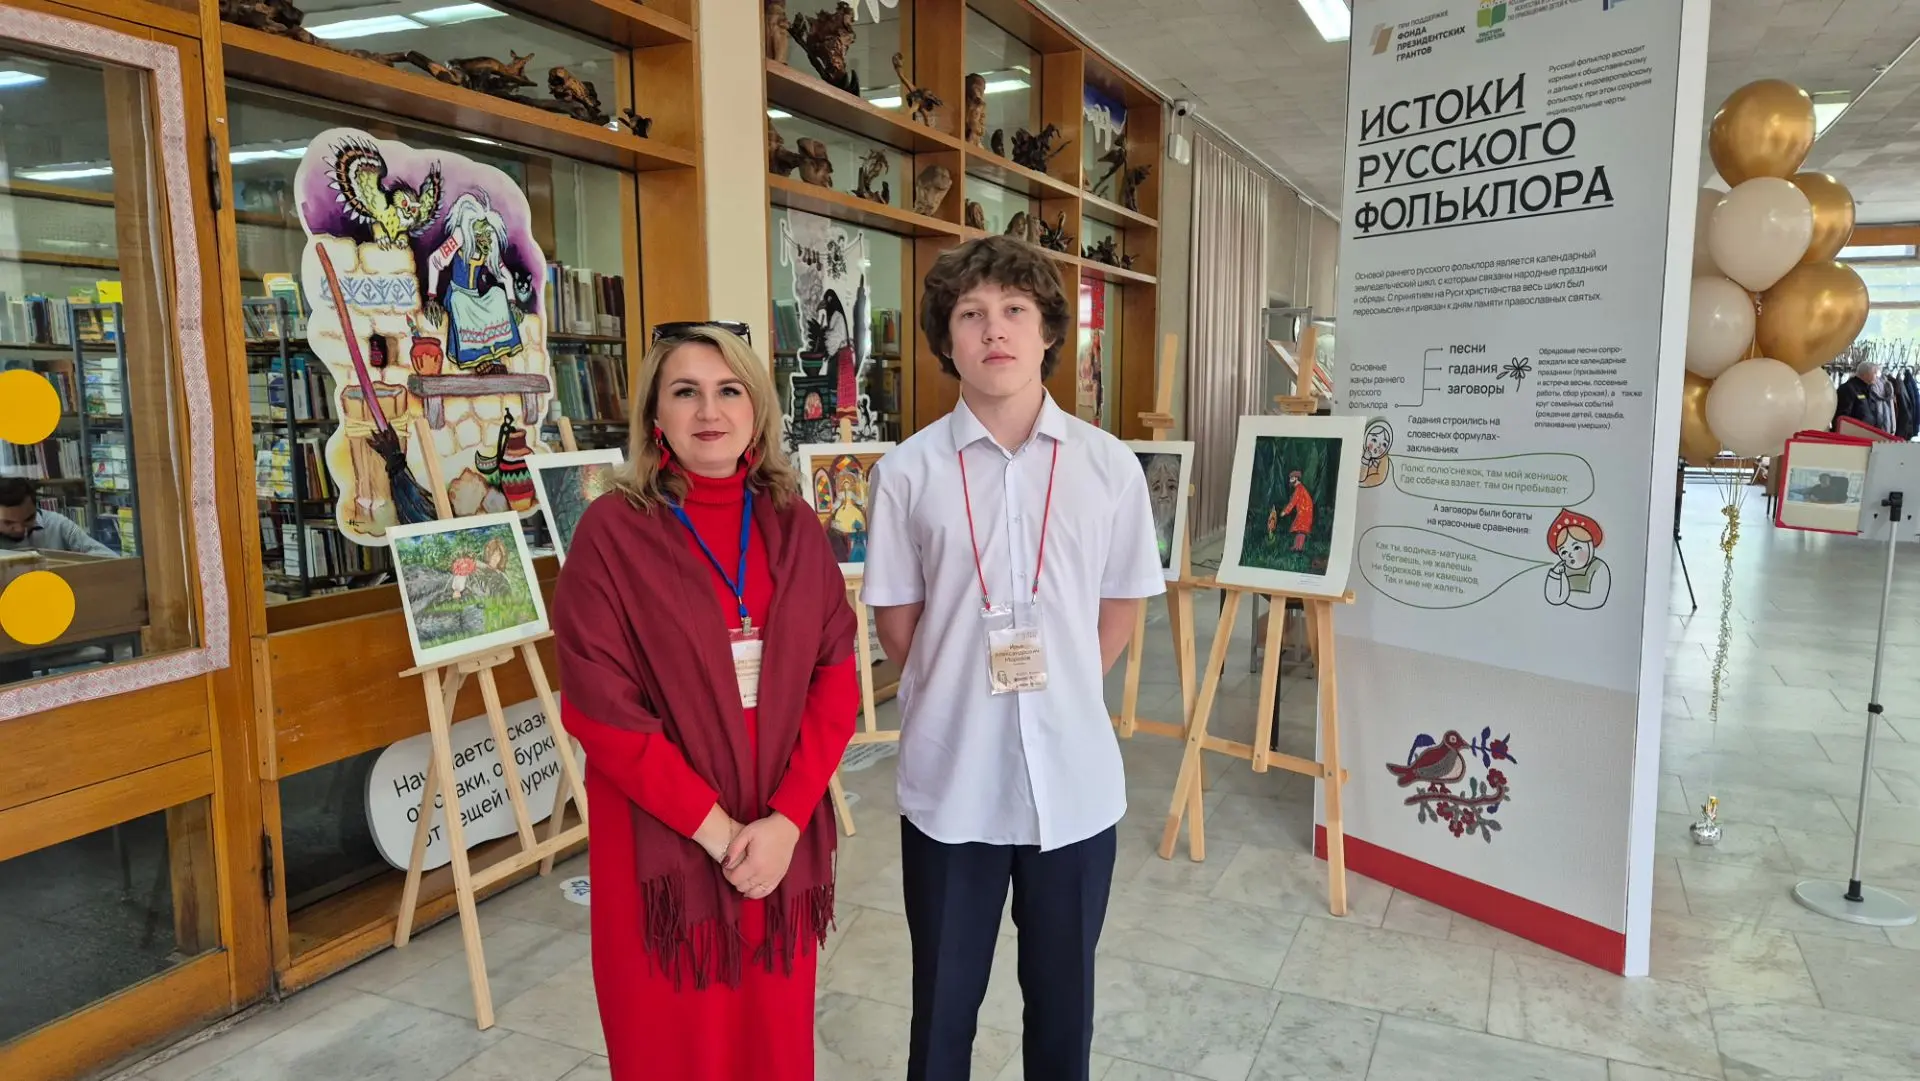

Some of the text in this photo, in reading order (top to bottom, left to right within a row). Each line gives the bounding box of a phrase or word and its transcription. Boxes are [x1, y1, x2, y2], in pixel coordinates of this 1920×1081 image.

[1397, 26, 1465, 51] ПРЕЗИДЕНТСКИХ
[1398, 26, 1426, 40] ФОНДА
[1396, 46, 1432, 62] ГРАНТОВ
[1549, 45, 1645, 72] Русский фольклор восходит
[1582, 56, 1647, 76] общеславянскому
[1553, 83, 1578, 94] дальше
[1584, 67, 1653, 87] индоевропейскому
[1585, 90, 1599, 99] при
[1599, 86, 1616, 95] этом
[1360, 72, 1526, 141] ИСТОКИ
[1357, 117, 1576, 188] РУССКОГО
[1354, 165, 1614, 233] ФОЛЬКЛОРА
[1354, 249, 1596, 280] Основой раннего русского фольклора является календарный
[1354, 280, 1417, 292] земледельческий
[1444, 275, 1477, 285] которым
[1479, 271, 1513, 282] связаны
[1514, 267, 1557, 279] народные
[1558, 263, 1607, 276] праздники
[1387, 293, 1393, 301] С
[1394, 291, 1434, 302] принятием
[1445, 288, 1464, 298] Руси
[1465, 284, 1521, 298] христианства
[1523, 282, 1542, 291] весь
[1544, 281, 1565, 291] цикл
[1567, 280, 1585, 288] был
[1353, 306, 1404, 317] переосмыслен
[1411, 304, 1446, 314] привязан
[1452, 301, 1473, 310] дням
[1474, 298, 1505, 308] памяти
[1504, 295, 1566, 308] православных
[1449, 344, 1486, 354] песни
[1539, 347, 1576, 355] Обрядовые
[1598, 346, 1622, 354] сопро-
[1350, 363, 1387, 372] Основные
[1448, 364, 1498, 375] гадания
[1350, 376, 1405, 385] жанры раннего
[1349, 389, 1381, 397] русского
[1447, 384, 1505, 397] заговоры
[1348, 400, 1388, 410] фольклора
[1408, 414, 1500, 426] Гадания строились на
[1407, 430, 1500, 443] словесных формулах-
[1406, 444, 1458, 454] заклинаниях
[1486, 469, 1502, 478] там
[1504, 469, 1523, 480] мой
[1400, 474, 1415, 484] Где
[1416, 476, 1450, 487] собачка
[1484, 482, 1501, 490] там
[1501, 483, 1514, 491] он
[1515, 483, 1569, 495] пребывает.
[1433, 503, 1533, 521] А заговоры были богаты
[1437, 518, 1481, 530] красочные
[1376, 541, 1389, 550] Как
[1434, 560, 1473, 572] жалеешь
[1384, 574, 1397, 584] Так
[1404, 578, 1421, 587] мне
[506, 711, 546, 742] сказ
[434, 771, 491, 809] свки,
[459, 789, 504, 828] ещей
[505, 760, 559, 802] урки
